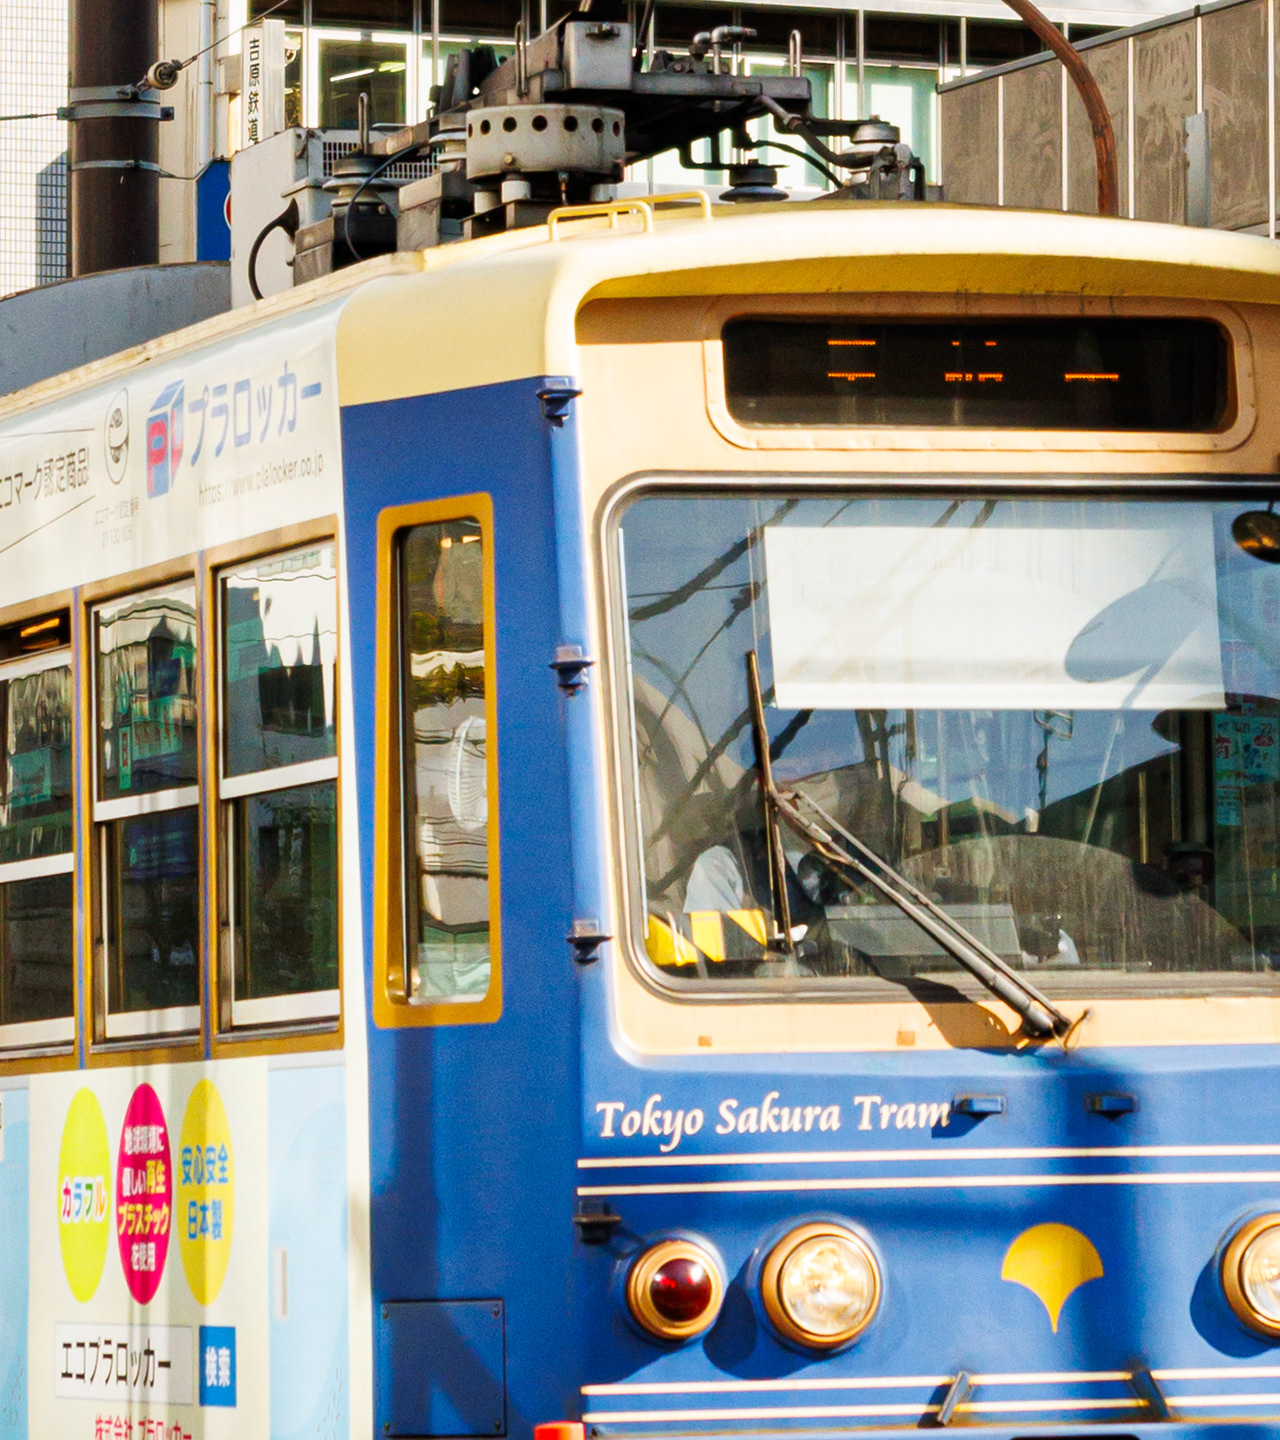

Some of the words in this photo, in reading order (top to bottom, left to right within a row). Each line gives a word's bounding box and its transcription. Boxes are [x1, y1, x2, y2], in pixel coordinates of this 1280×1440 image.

[188, 360, 323, 467] プラロッカー
[596, 1094, 704, 1153] Tokyo
[715, 1091, 841, 1135] Sakura
[853, 1094, 951, 1132] Tram
[181, 1143, 229, 1186] 安心安全
[61, 1176, 106, 1223] カラフル
[118, 1202, 170, 1236] プラスチック
[187, 1199, 223, 1241] 日本製
[61, 1336, 172, 1389] エコプラロッカー
[204, 1345, 231, 1388] 検索
